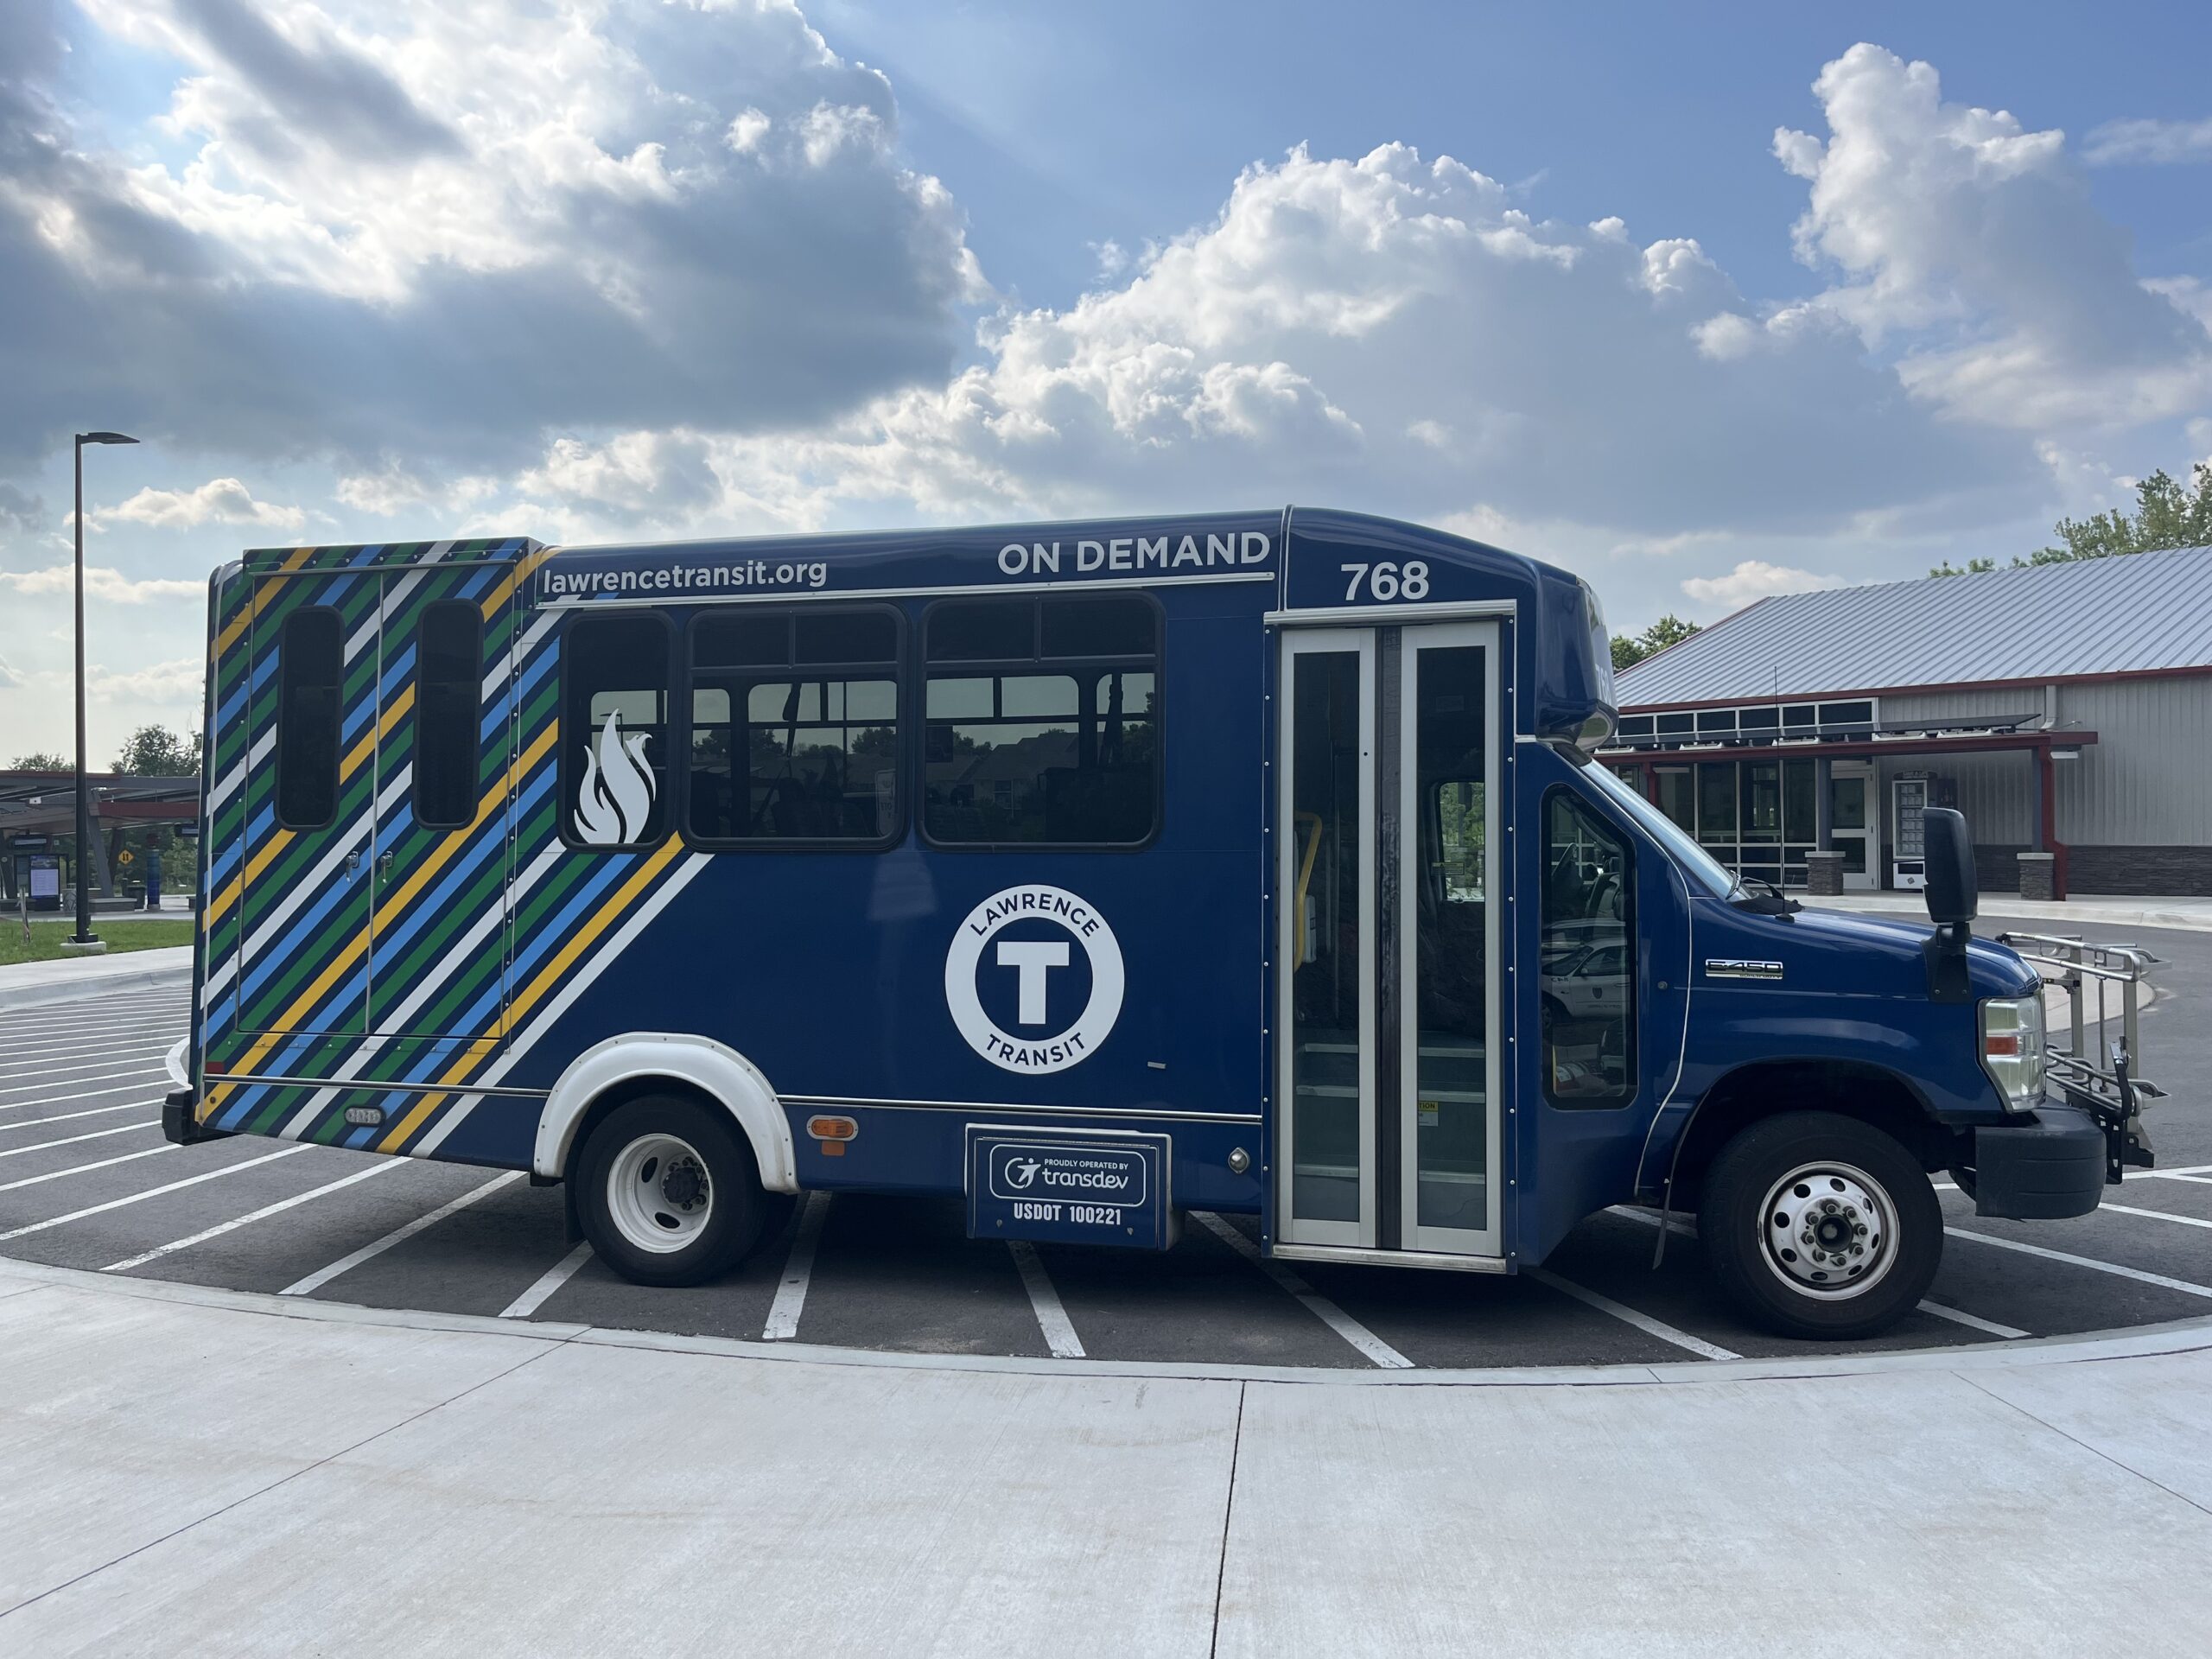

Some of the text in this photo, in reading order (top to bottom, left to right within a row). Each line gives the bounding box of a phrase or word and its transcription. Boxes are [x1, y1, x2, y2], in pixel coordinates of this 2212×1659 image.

[997, 531, 1271, 575] ON DEMAND
[543, 559, 828, 594] lawrencetransit.org
[1340, 561, 1430, 601] 768
[969, 893, 1100, 938] LAWRENCE
[997, 941, 1070, 1025] T
[986, 1033, 1085, 1066] TRANSIT
[1041, 1167, 1129, 1190] transdev
[1044, 1158, 1078, 1167] PROUDLY
[1079, 1160, 1118, 1170] OPERATED
[1014, 1202, 1122, 1225] USDOT 100221
